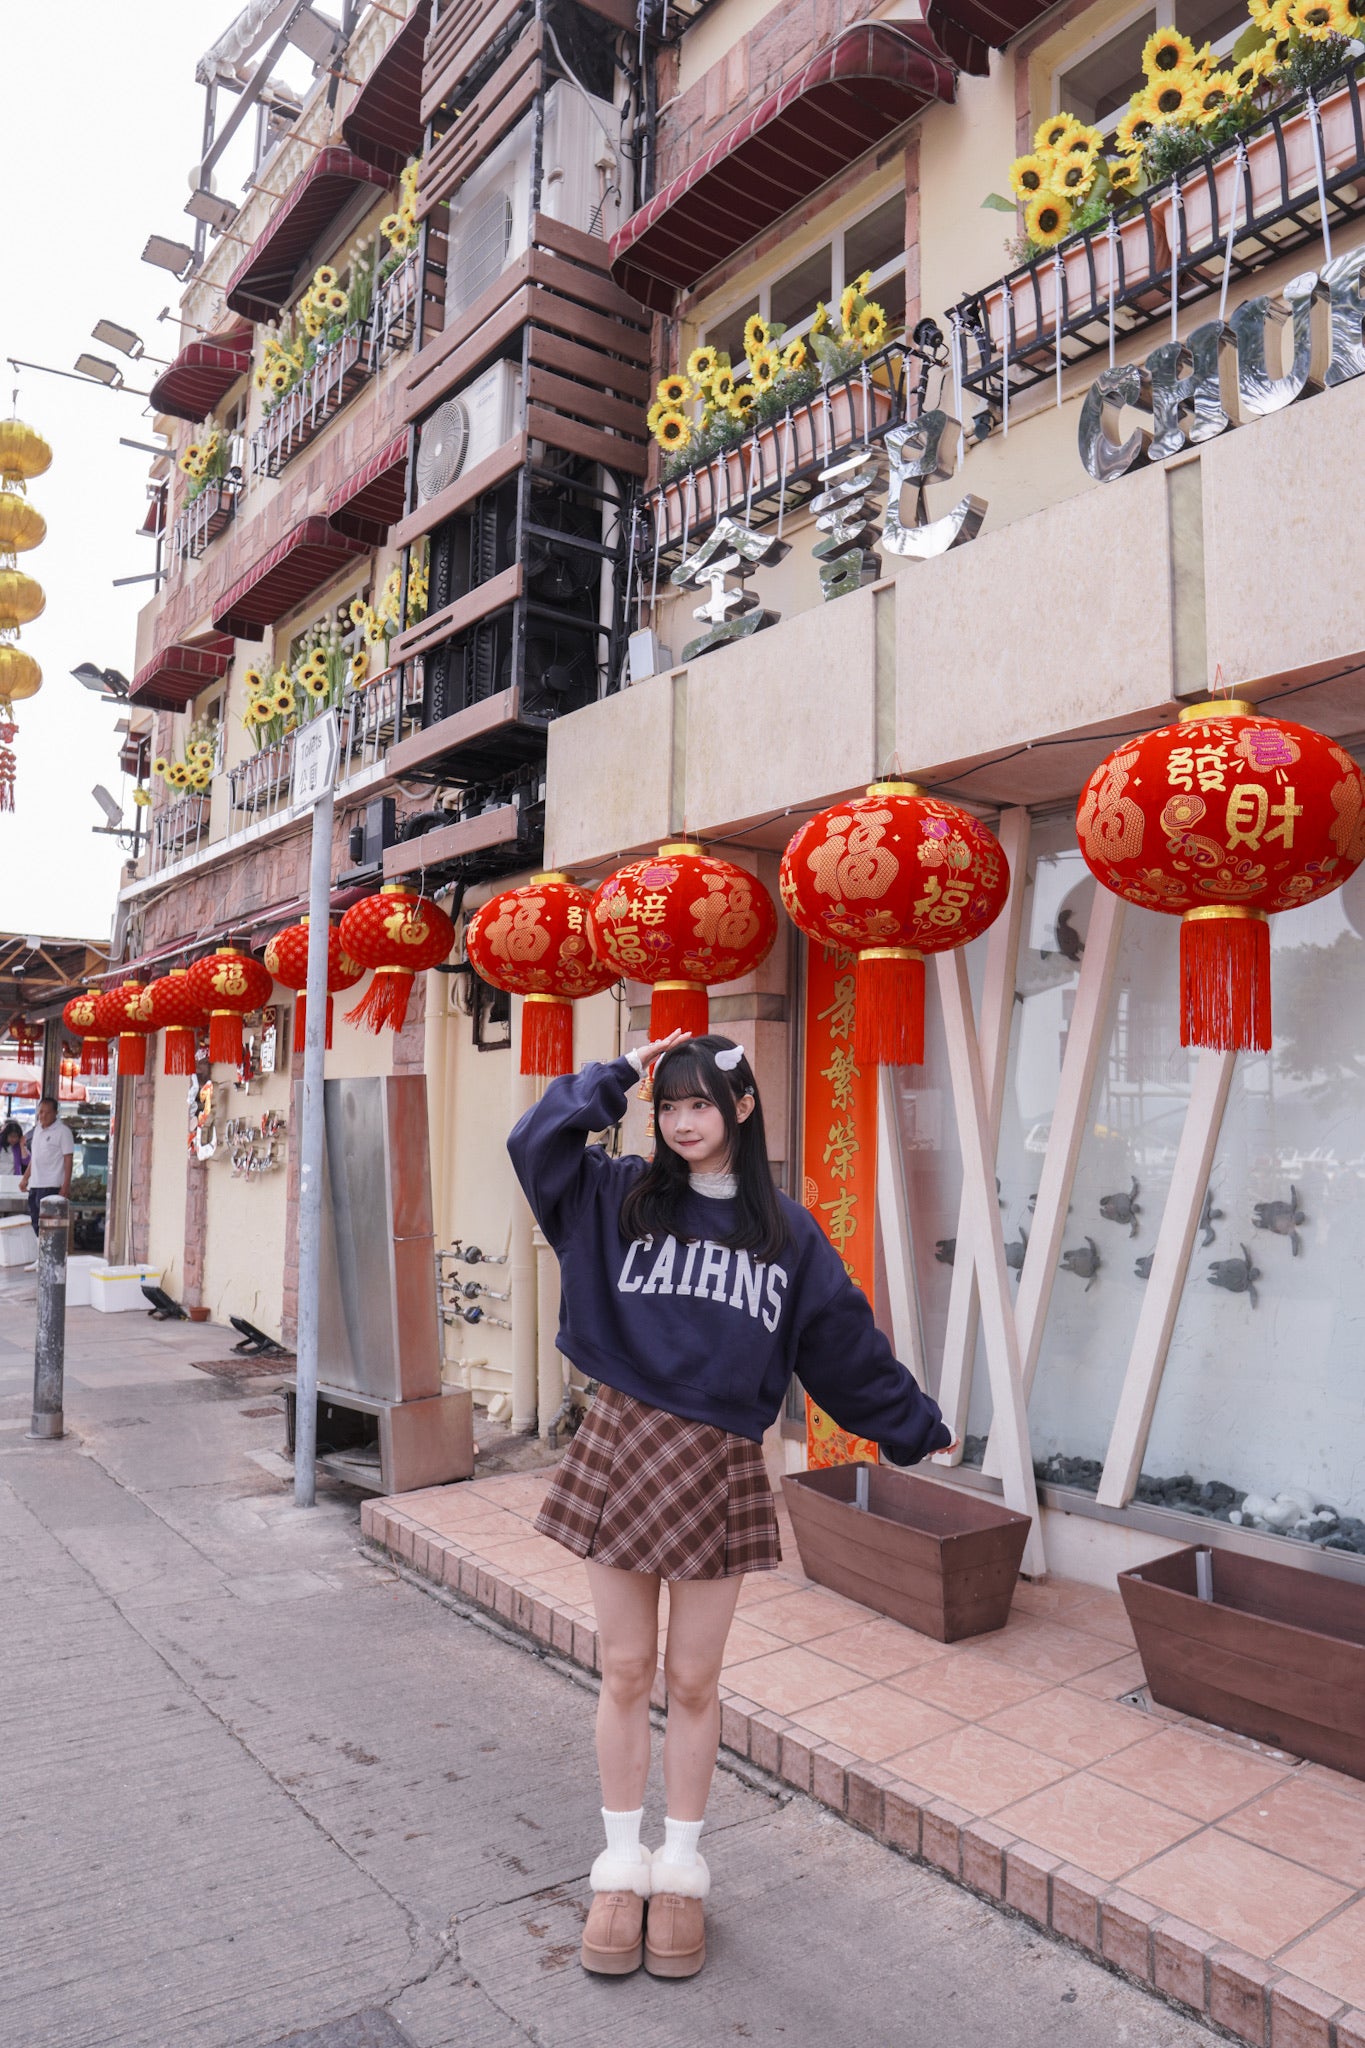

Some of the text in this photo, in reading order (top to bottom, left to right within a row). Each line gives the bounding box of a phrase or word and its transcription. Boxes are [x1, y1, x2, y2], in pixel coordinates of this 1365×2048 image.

[301, 735, 322, 760] Toilets
[807, 810, 899, 900] 福
[485, 897, 551, 962] 福
[690, 873, 760, 949] 福
[70, 1001, 95, 1026] 福
[211, 963, 249, 996] 福
[816, 940, 863, 1286] 景繁榮事
[617, 1233, 788, 1333] CAIRNS
